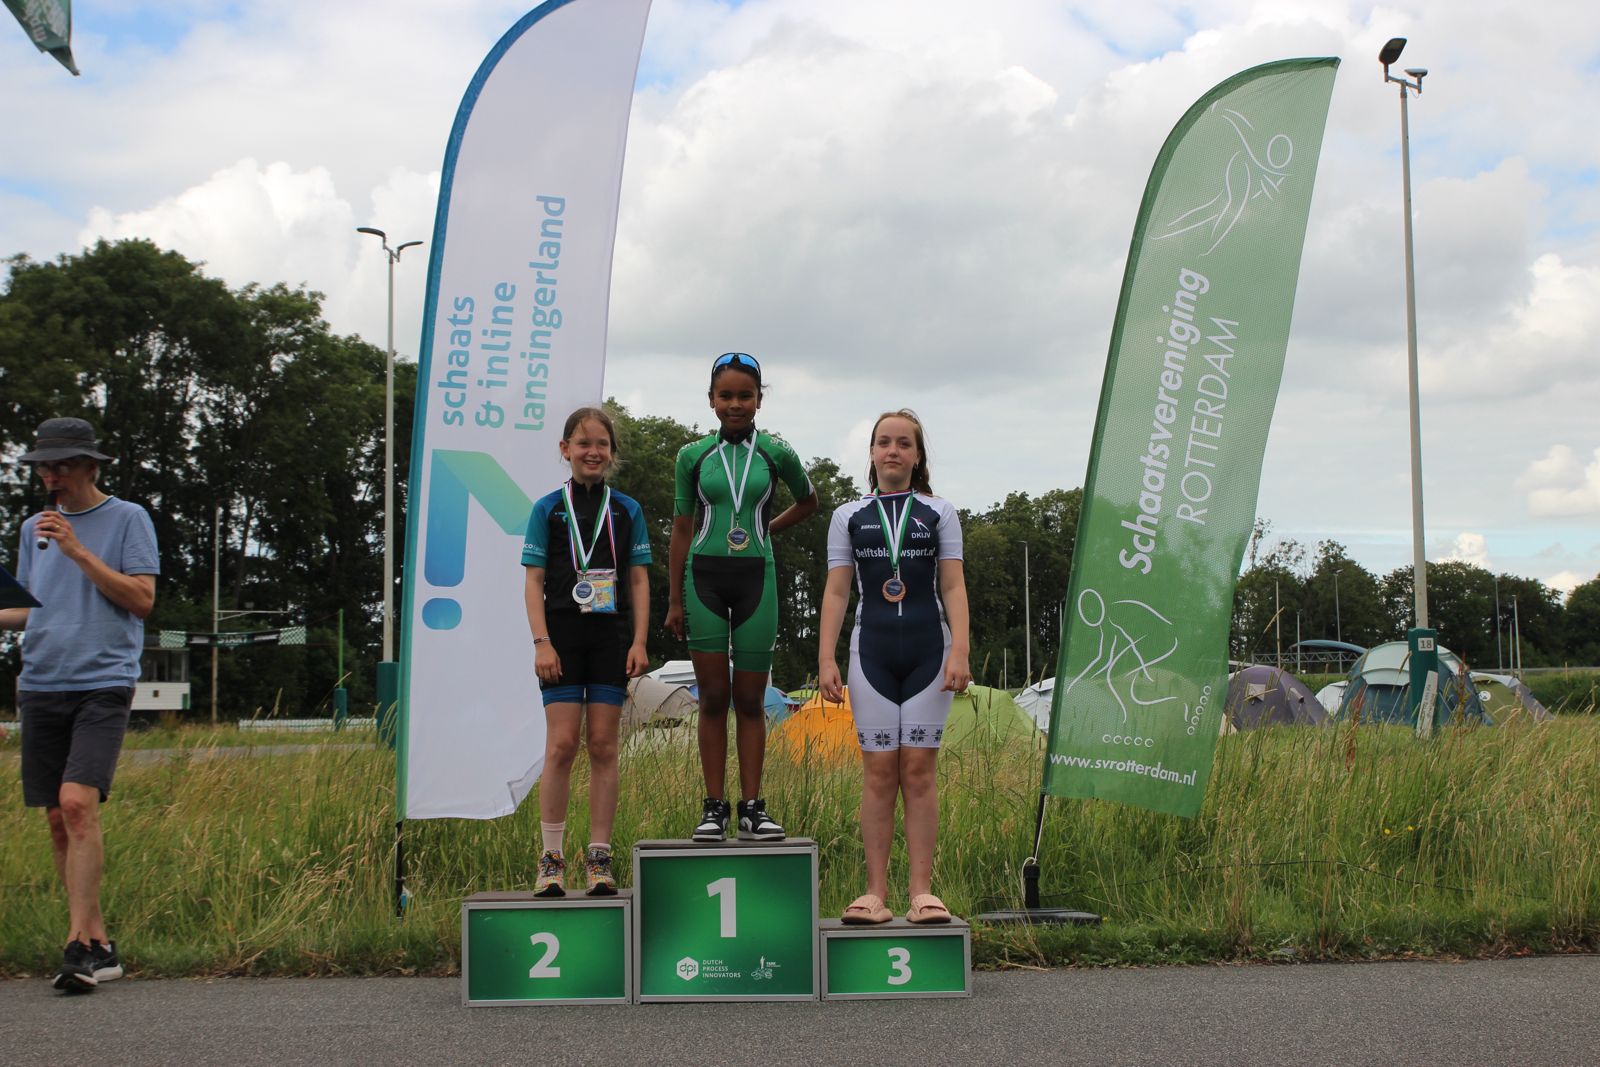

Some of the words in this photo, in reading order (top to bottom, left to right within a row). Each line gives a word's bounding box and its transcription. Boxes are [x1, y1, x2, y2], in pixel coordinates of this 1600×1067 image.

[477, 282, 516, 389] inline
[514, 195, 566, 431] lansingerland
[438, 296, 474, 426] schaats
[475, 401, 504, 428] &
[1119, 267, 1209, 575] Schaatsvereniging
[1176, 316, 1239, 526] ROTTERDAM
[855, 547, 936, 558] Delftsblawsport.nl
[1421, 640, 1432, 648] 18
[1050, 752, 1197, 786] www.svrotterdam.nl
[706, 877, 737, 938] 1
[528, 931, 561, 979] 2
[887, 947, 913, 986] 3
